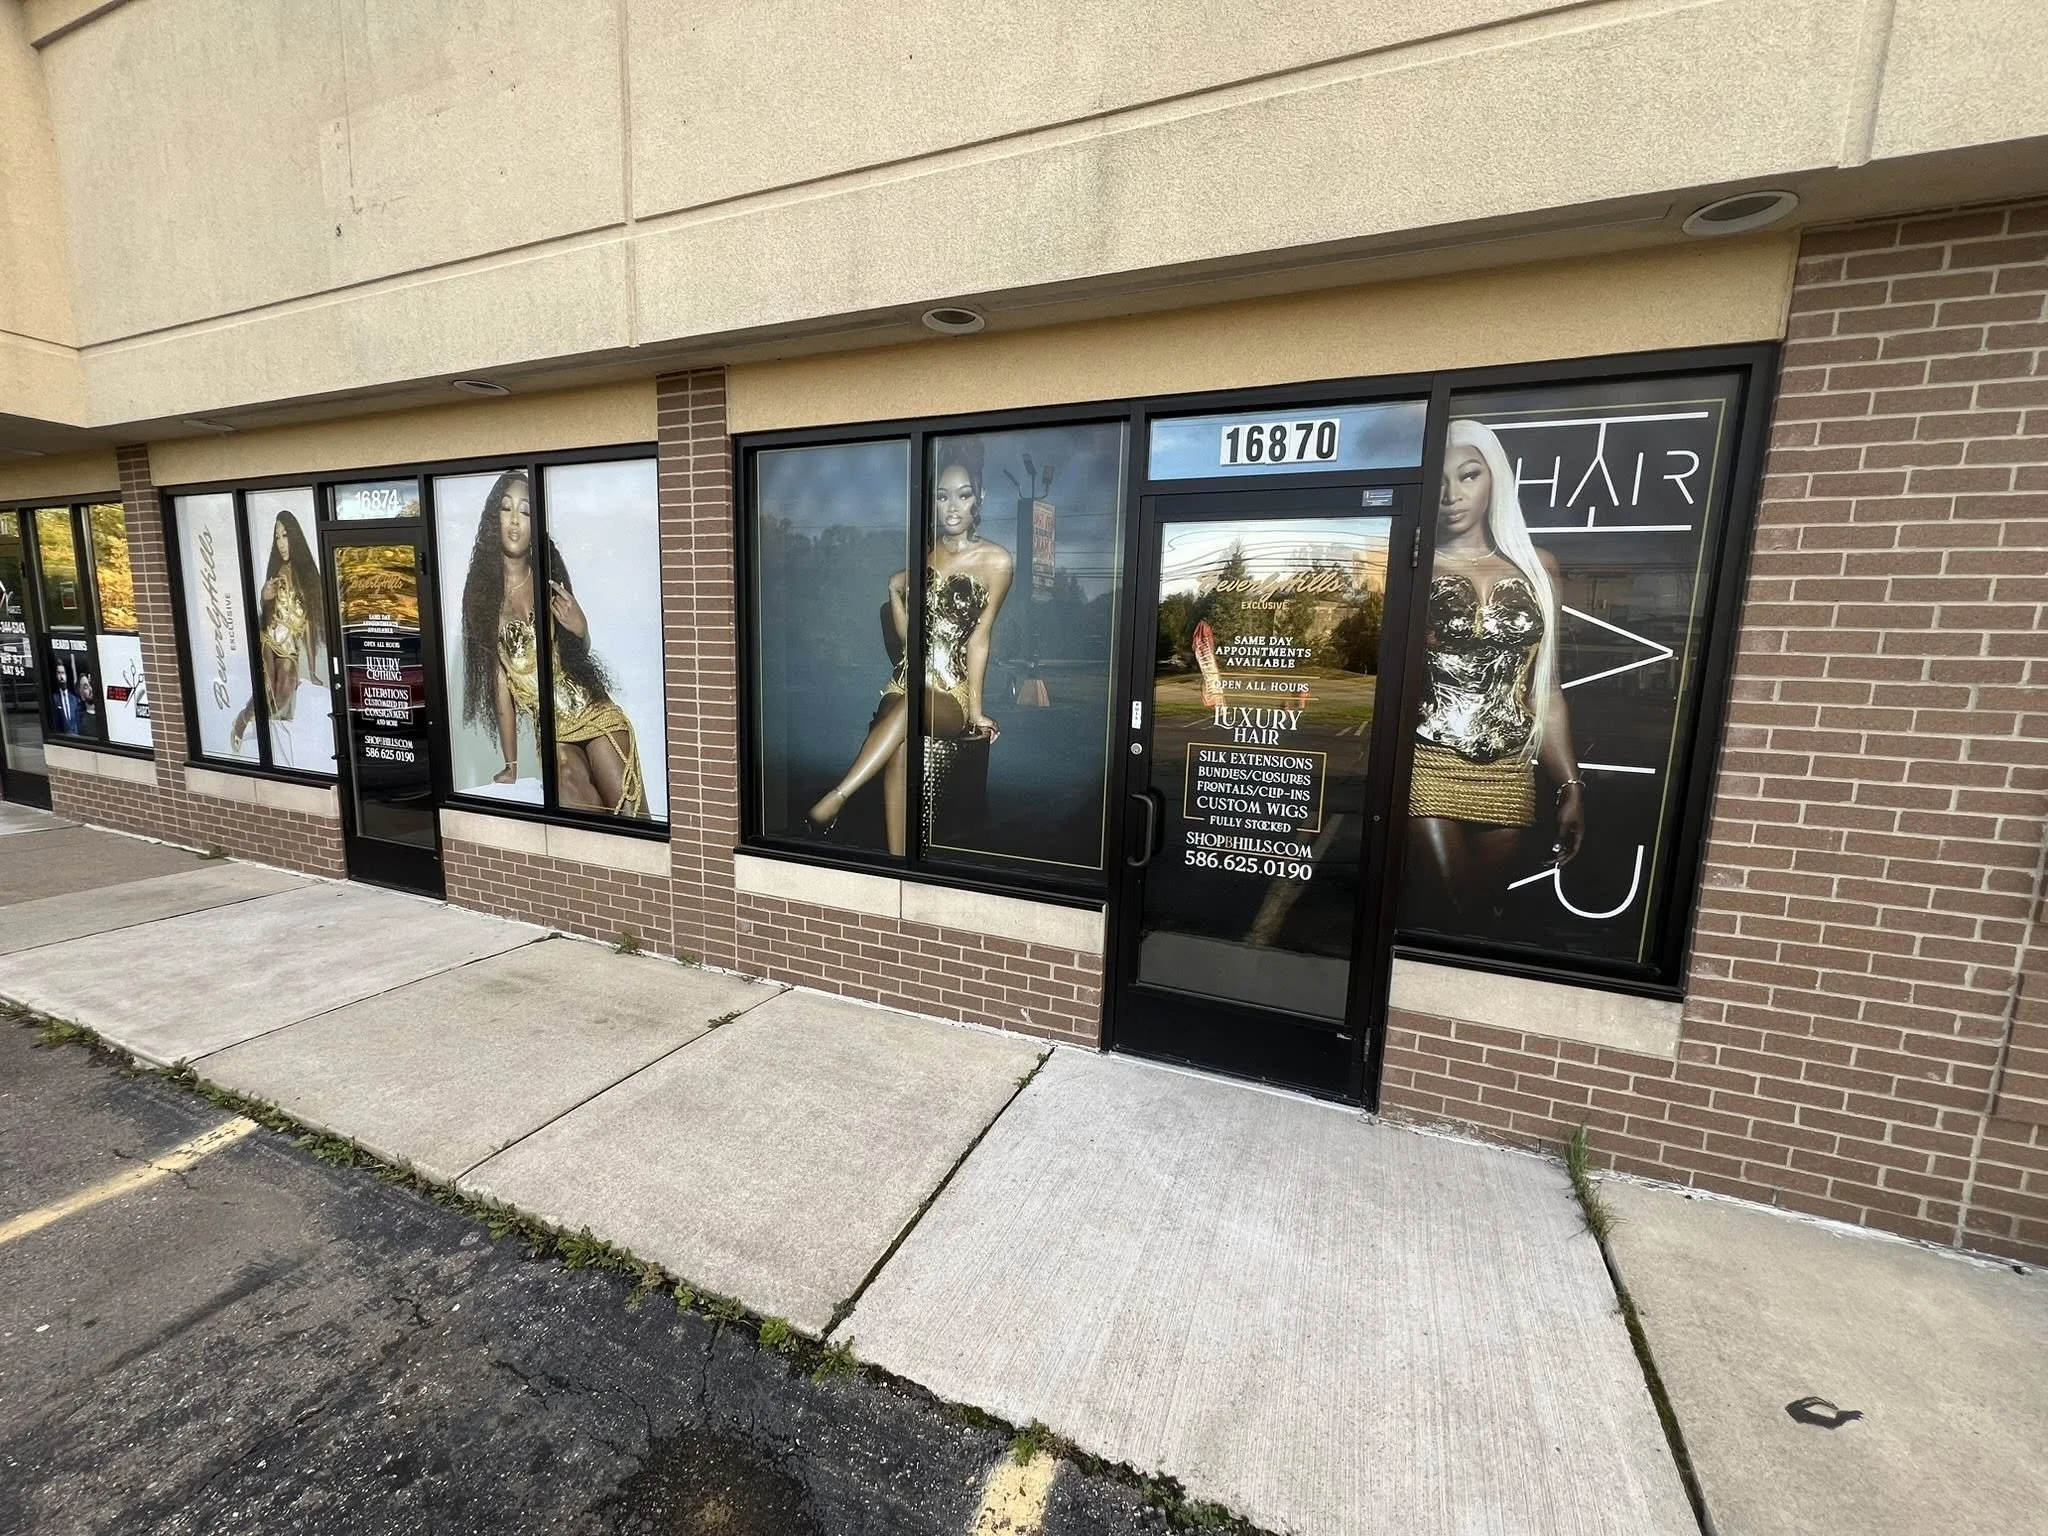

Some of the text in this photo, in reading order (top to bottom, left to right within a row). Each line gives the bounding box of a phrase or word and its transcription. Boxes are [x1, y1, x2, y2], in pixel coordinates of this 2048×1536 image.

[1226, 421, 1337, 463] 16870
[1514, 450, 1701, 508] HAIR
[355, 489, 399, 511] 16874
[1241, 601, 1288, 610] EXCLUSIVE
[225, 592, 236, 651] EXCLUSIVE
[1234, 635, 1294, 646] SAME DAY
[1215, 646, 1312, 658] APPOINTMENTS
[366, 656, 400, 671] LUXURY
[1226, 657, 1296, 668] AVAILABLE
[366, 670, 402, 681] CLOTHING
[364, 687, 409, 700] ALTERATIONS
[1214, 680, 1309, 692] OPEN ALL HOURS
[364, 708, 409, 720] CONSIGNMENT
[1213, 705, 1303, 731] LUXURY
[1233, 727, 1280, 745] HAIR
[1199, 750, 1313, 770] SILK EXTENSIONS
[1198, 766, 1311, 786] BUNDLES/CLOSURES
[1197, 780, 1310, 801] FRONTALS/CLIP-INS
[1196, 796, 1308, 819] CUSTOM WIGS
[1210, 815, 1291, 833] FULLY STOCKED
[1186, 831, 1313, 859] SHOPBHILLS.COM
[1184, 850, 1313, 881] 586.625.0190
